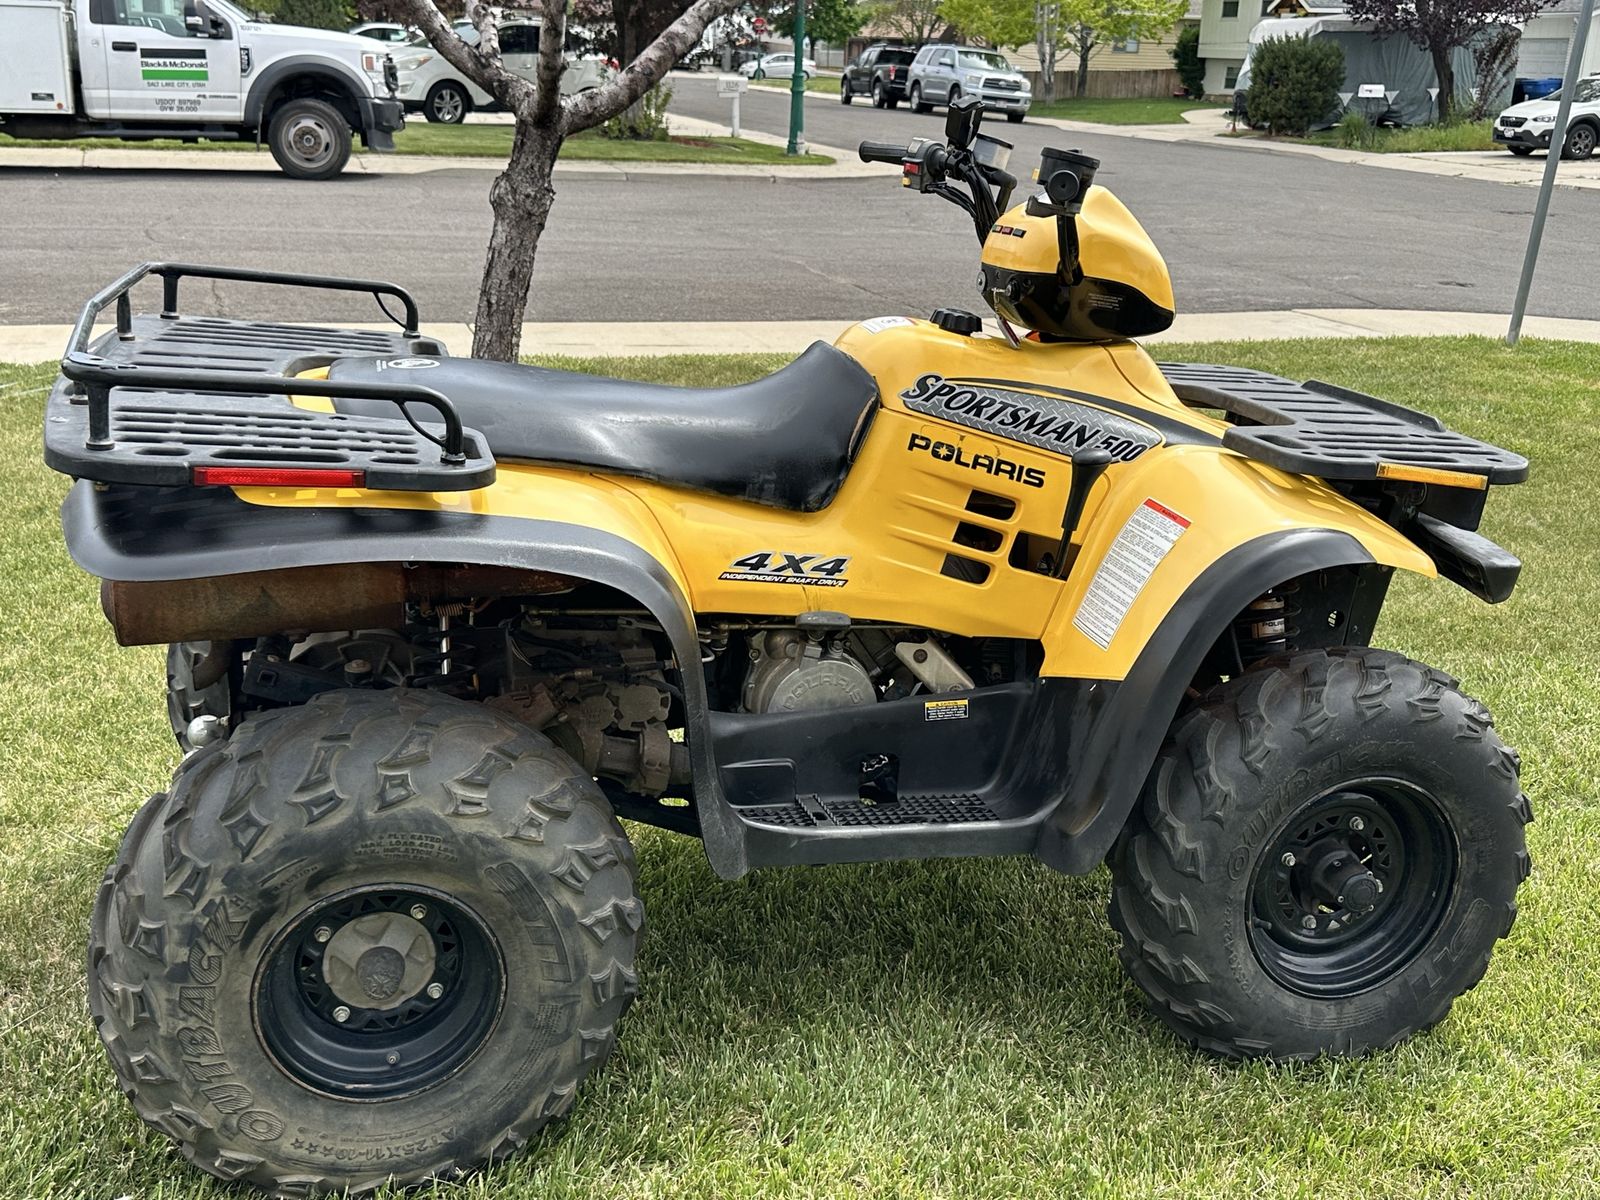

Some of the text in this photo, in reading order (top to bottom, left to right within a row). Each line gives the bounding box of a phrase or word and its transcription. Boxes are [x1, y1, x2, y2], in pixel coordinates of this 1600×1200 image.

[899, 374, 1151, 462] SPORTSMAN 500
[907, 432, 1046, 488] POLARIS
[721, 572, 846, 588] INDEPENDENT SHAFT DRIVE
[783, 672, 863, 710] POLARIS
[177, 897, 284, 1142] OUTBACK
